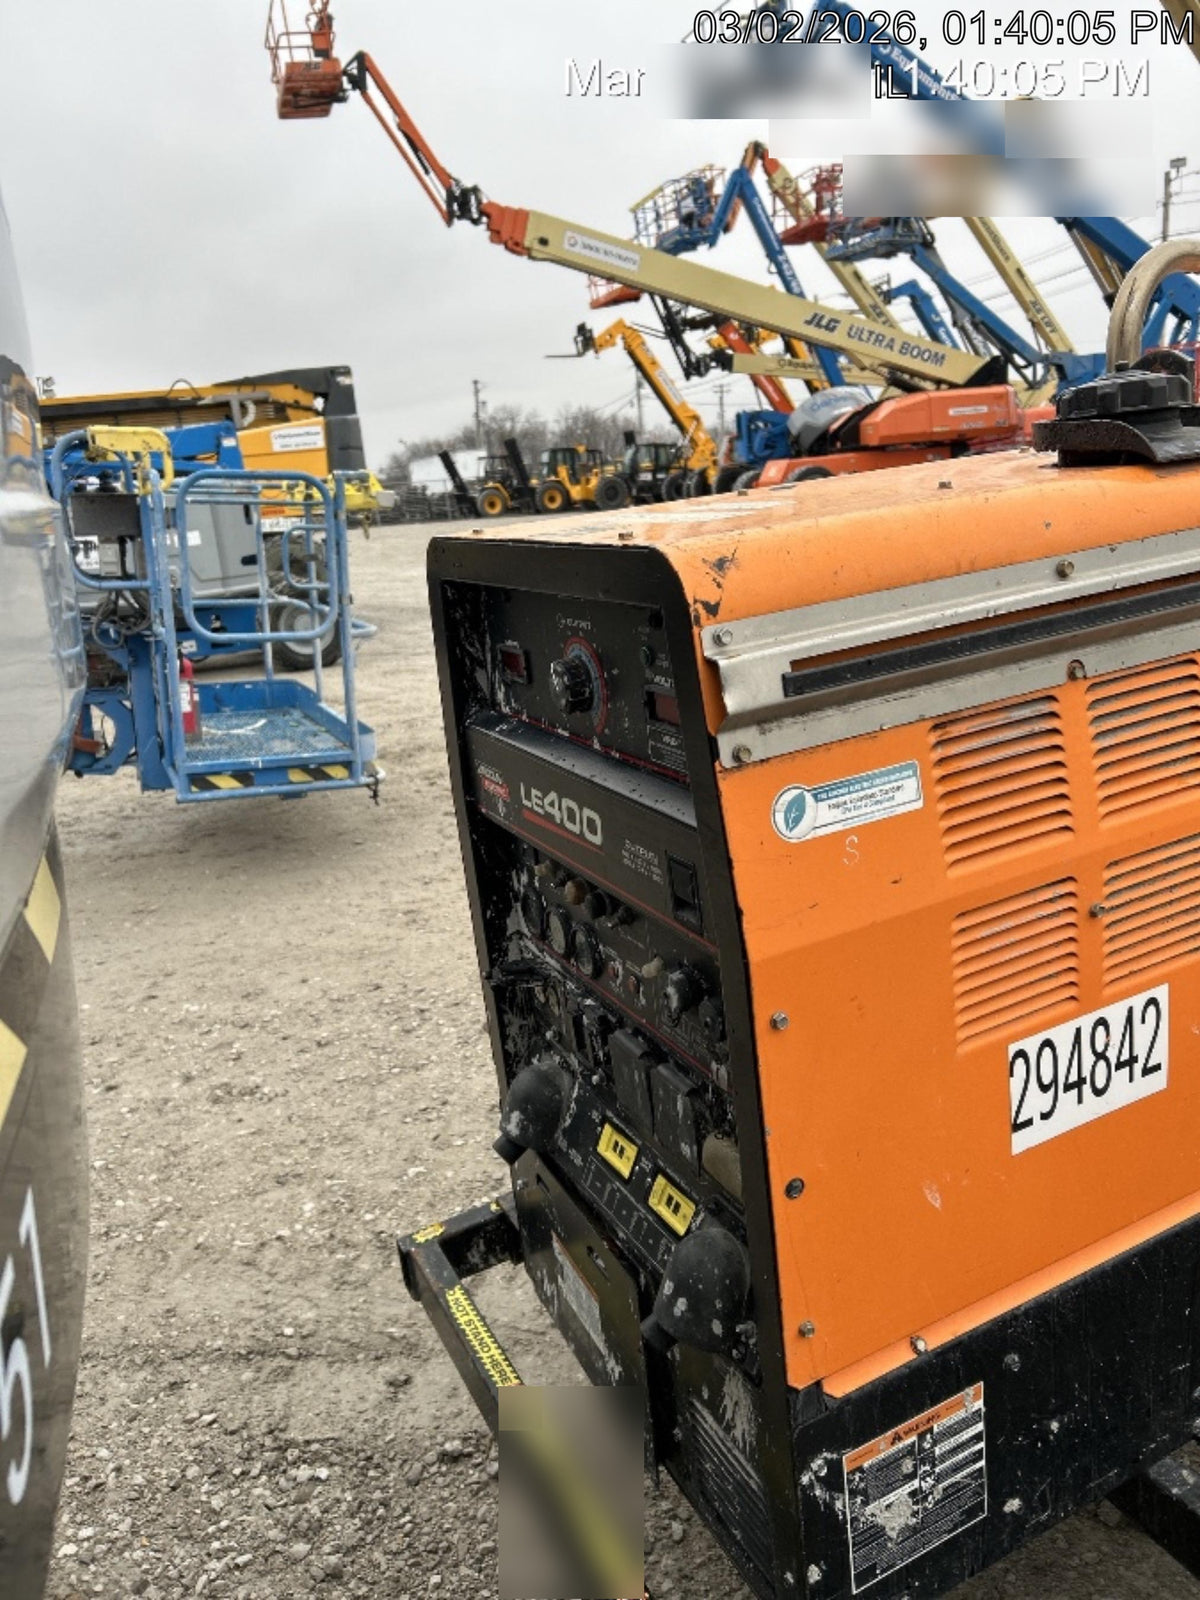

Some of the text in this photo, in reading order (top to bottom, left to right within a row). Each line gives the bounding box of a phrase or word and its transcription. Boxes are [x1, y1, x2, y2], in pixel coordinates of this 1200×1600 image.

[804, 312, 841, 333] JLG
[847, 323, 896, 352] ULTRA
[898, 340, 946, 367] BOOM
[519, 781, 604, 846] LE400
[1009, 996, 1163, 1133] 294842
[463, 1318, 492, 1355] STAND
